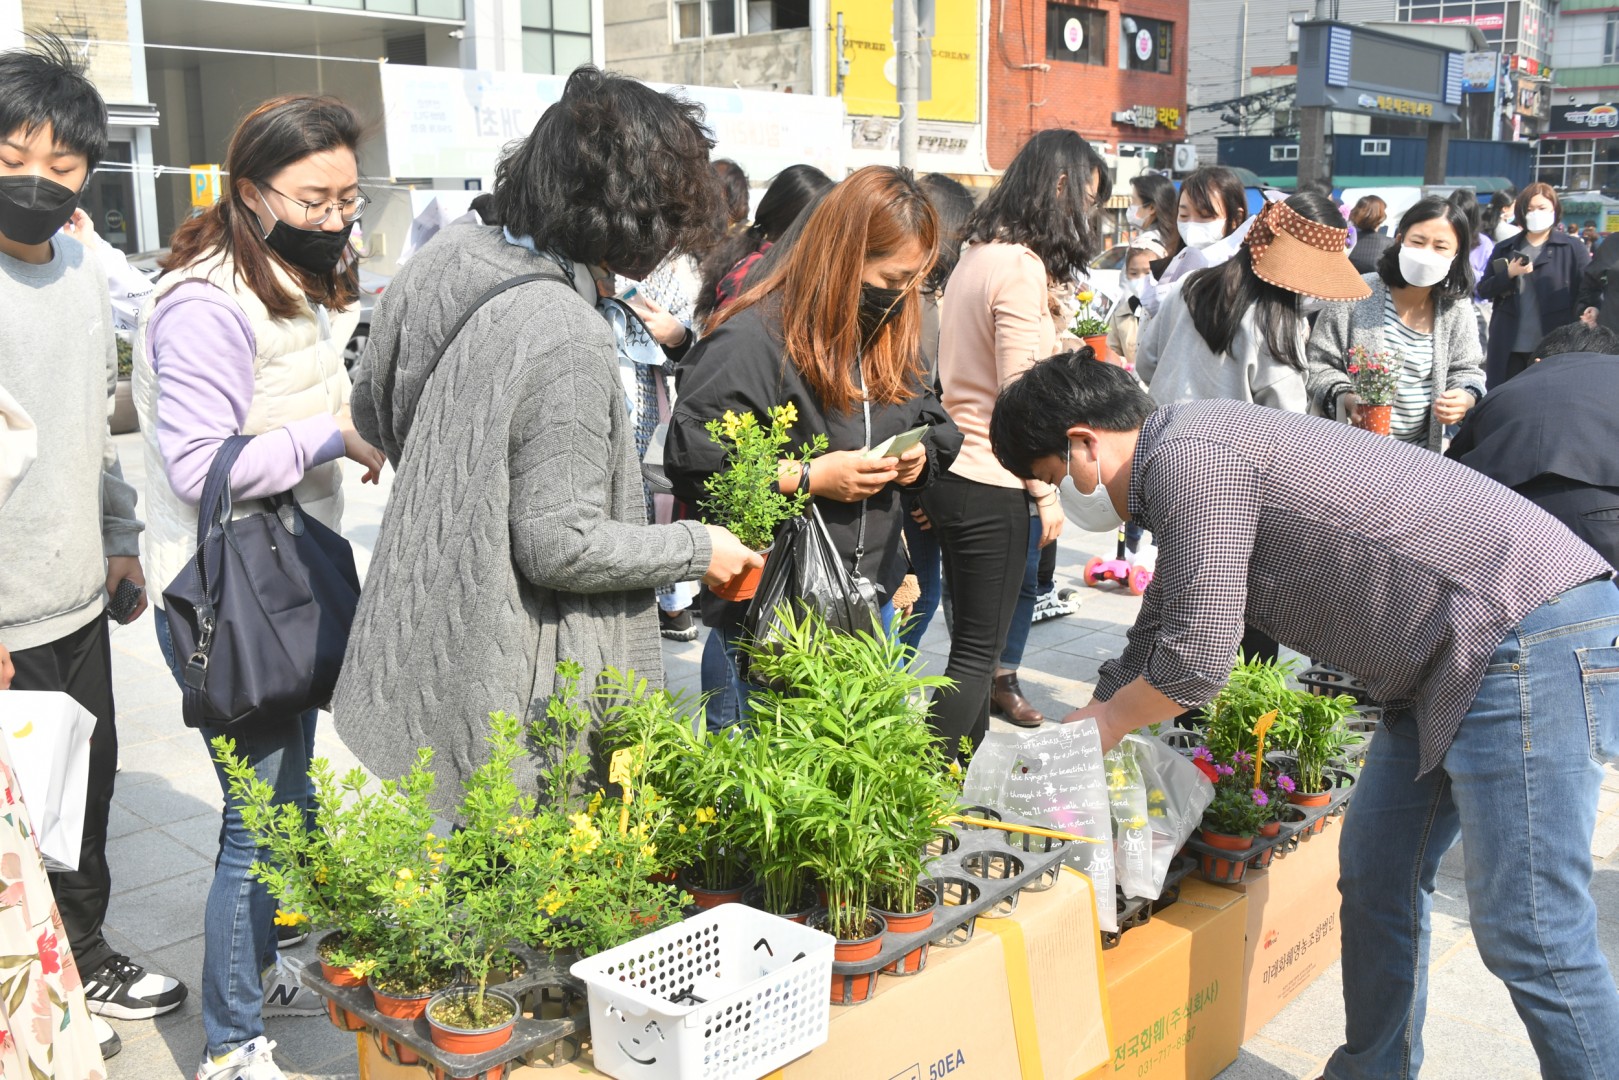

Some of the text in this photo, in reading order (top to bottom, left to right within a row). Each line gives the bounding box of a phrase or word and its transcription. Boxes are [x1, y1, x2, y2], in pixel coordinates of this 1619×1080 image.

[837, 37, 886, 52] OFTREE
[1263, 912, 1335, 985] 미래화훼영농조합법인
[267, 983, 299, 1005] N
[1114, 979, 1219, 1072] 전국화훼(주식회사)
[929, 1048, 966, 1080] 50EA
